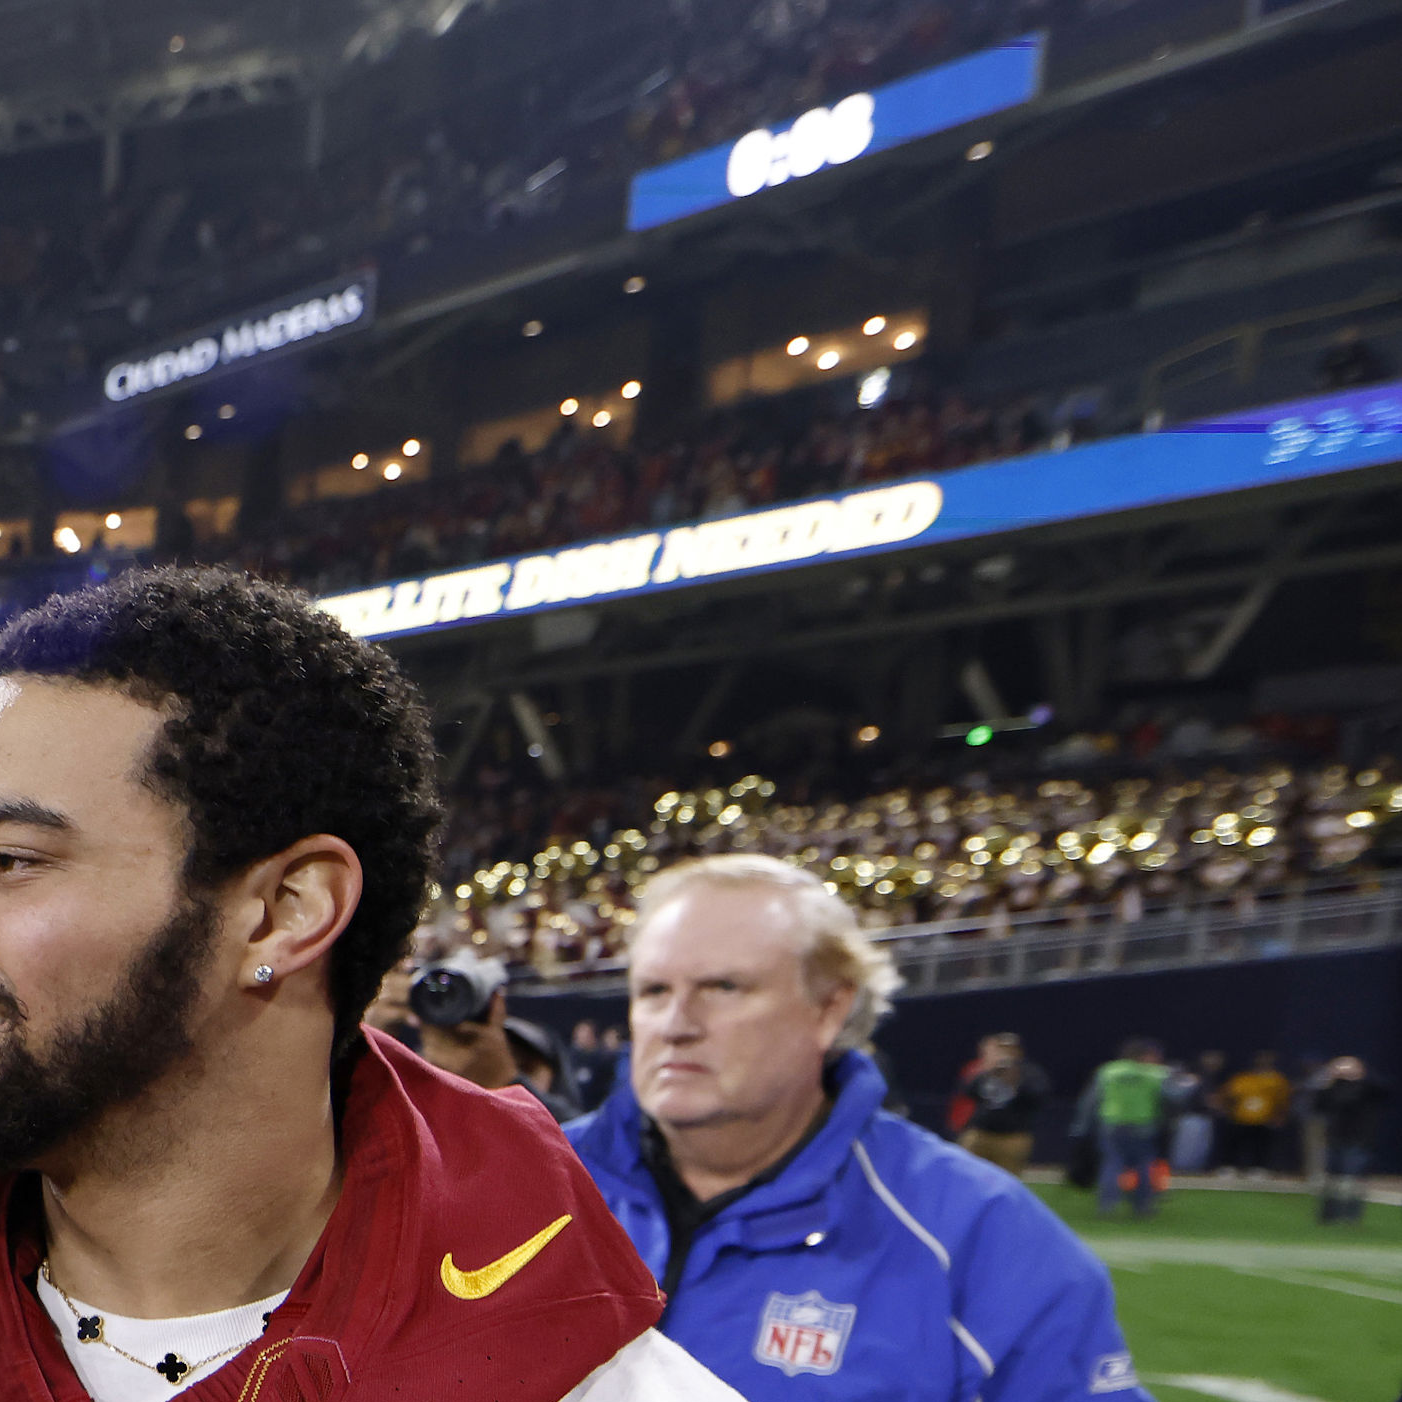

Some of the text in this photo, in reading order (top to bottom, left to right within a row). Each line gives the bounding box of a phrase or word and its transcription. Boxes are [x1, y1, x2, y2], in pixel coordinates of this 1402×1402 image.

[505, 534, 661, 610] DISH
[653, 481, 942, 583] NEEDED
[766, 1324, 833, 1367] NFL
